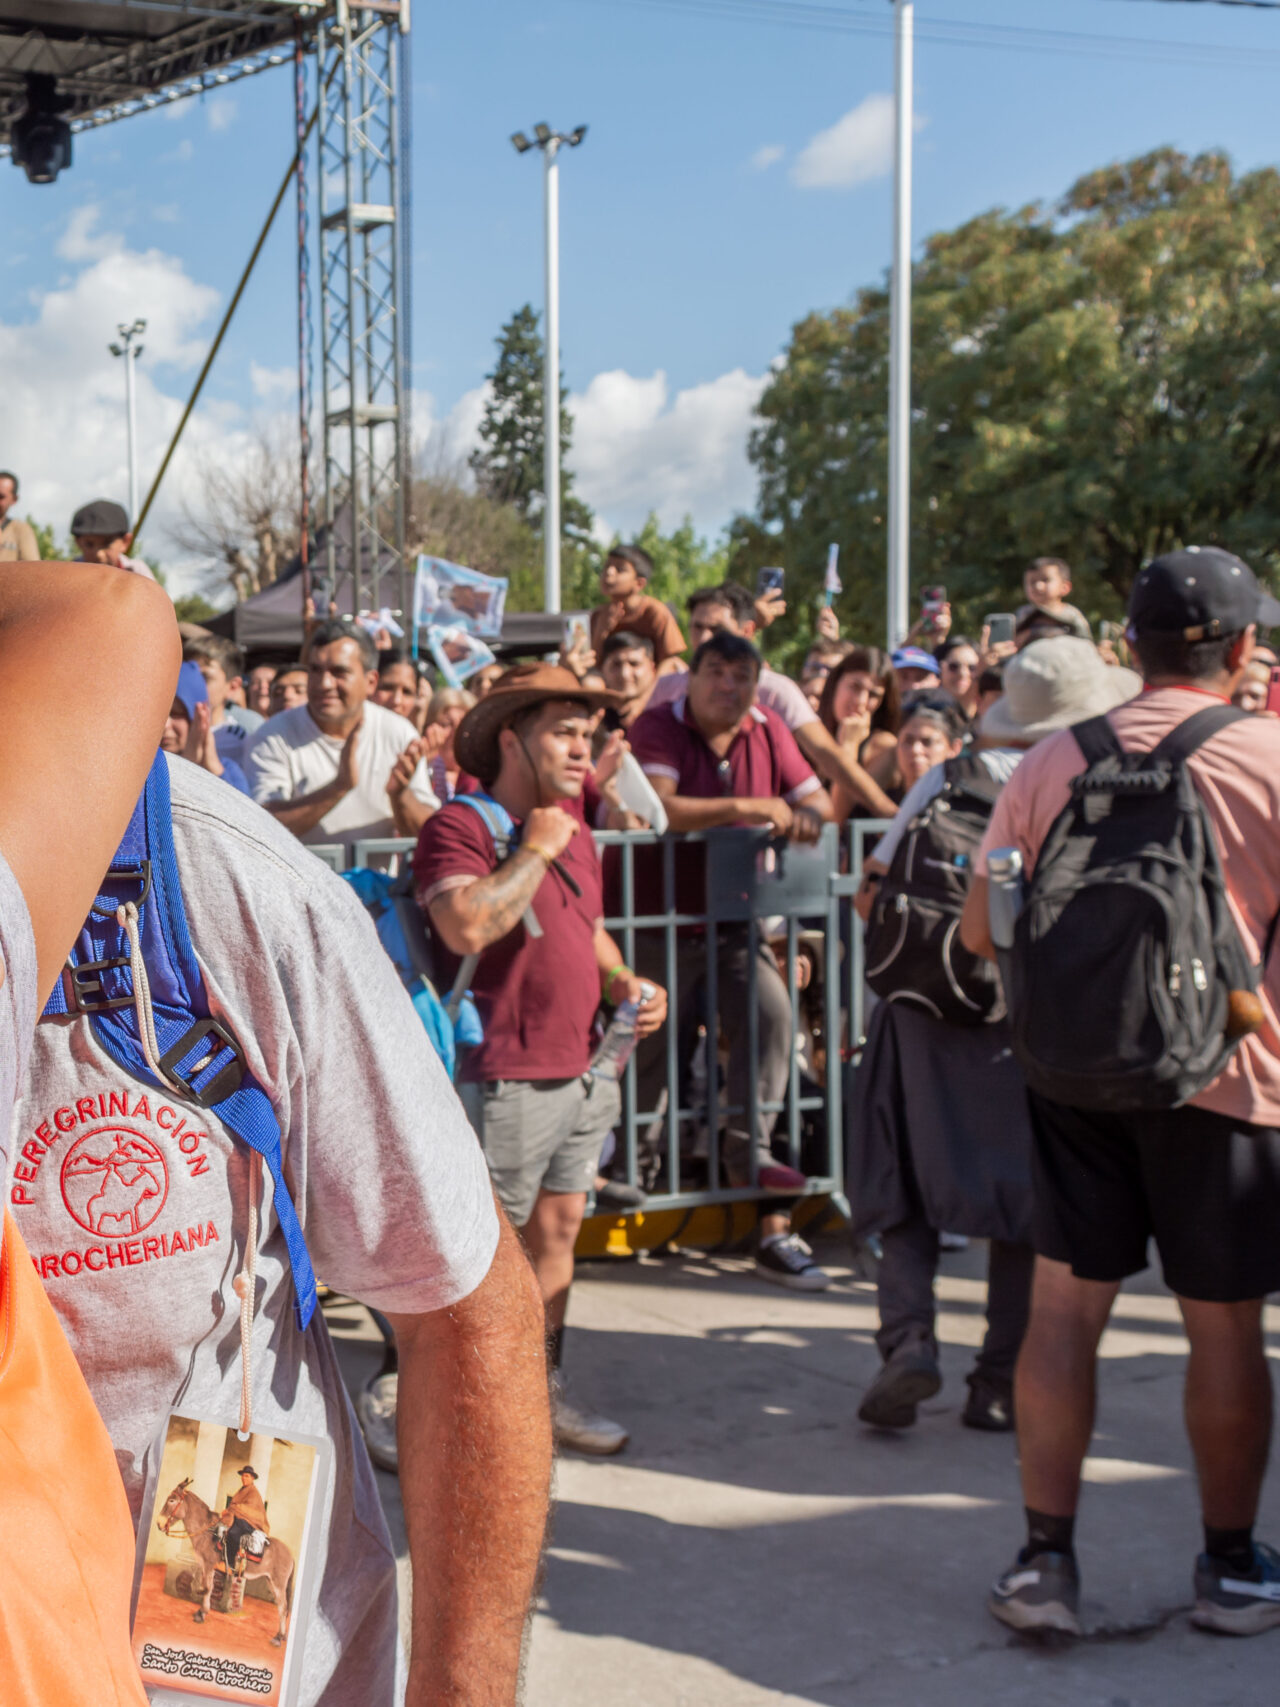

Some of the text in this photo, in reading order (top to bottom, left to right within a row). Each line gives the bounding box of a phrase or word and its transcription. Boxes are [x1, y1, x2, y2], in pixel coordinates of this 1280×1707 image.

[11, 1091, 210, 1205] PEREGRINACIÓN
[141, 1655, 272, 1694] Santo Cura Brochero
[144, 1643, 273, 1680] San José Gabriel del Rosario
